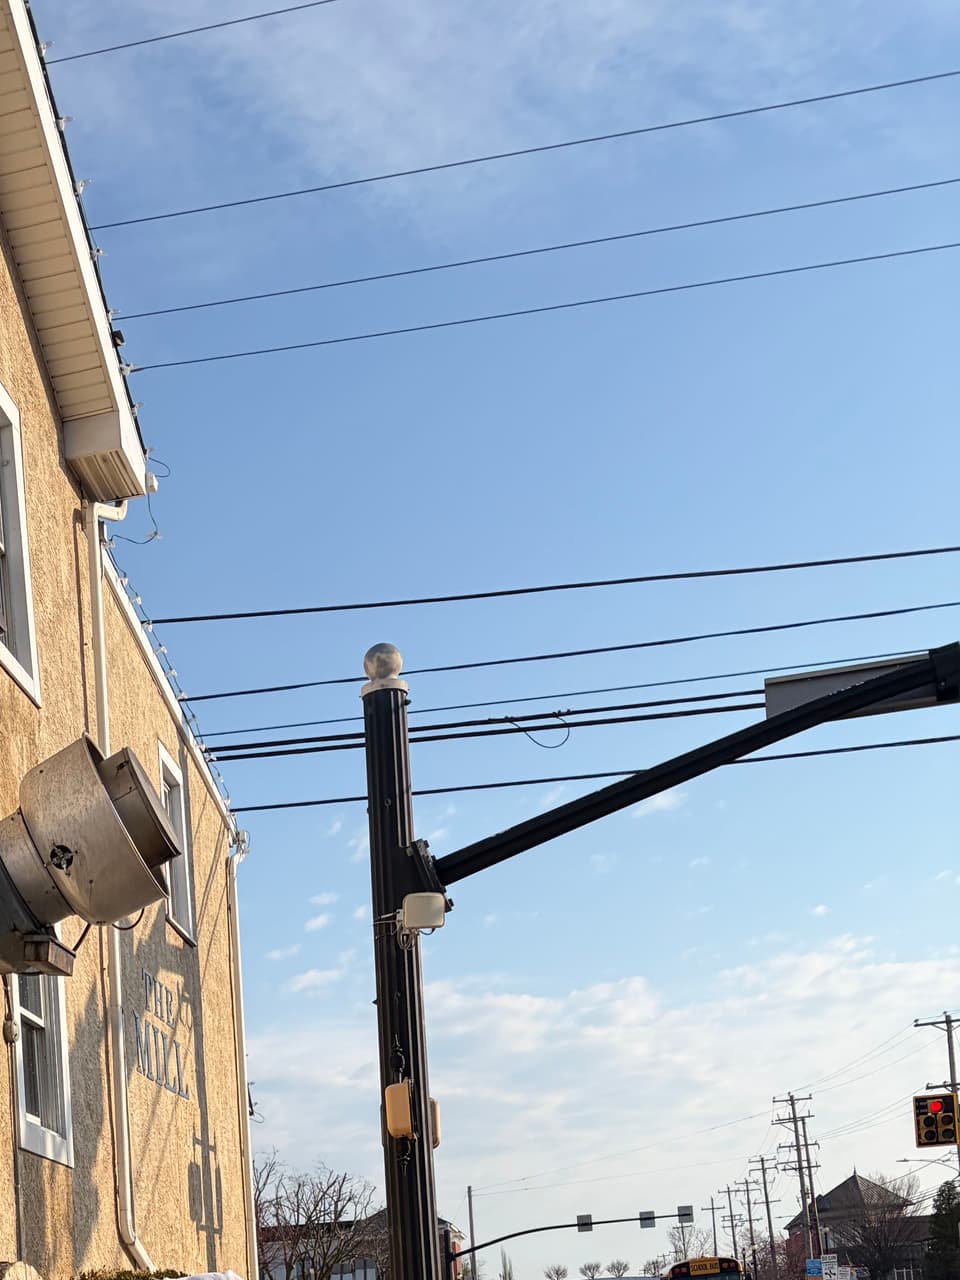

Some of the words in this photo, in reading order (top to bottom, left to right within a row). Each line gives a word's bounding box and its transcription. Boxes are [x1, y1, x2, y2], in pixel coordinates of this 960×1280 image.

[142, 968, 176, 1029] THE
[133, 1009, 189, 1099] MILL
[690, 1262, 708, 1271] SCHOOL
[709, 1261, 720, 1269] BUS
